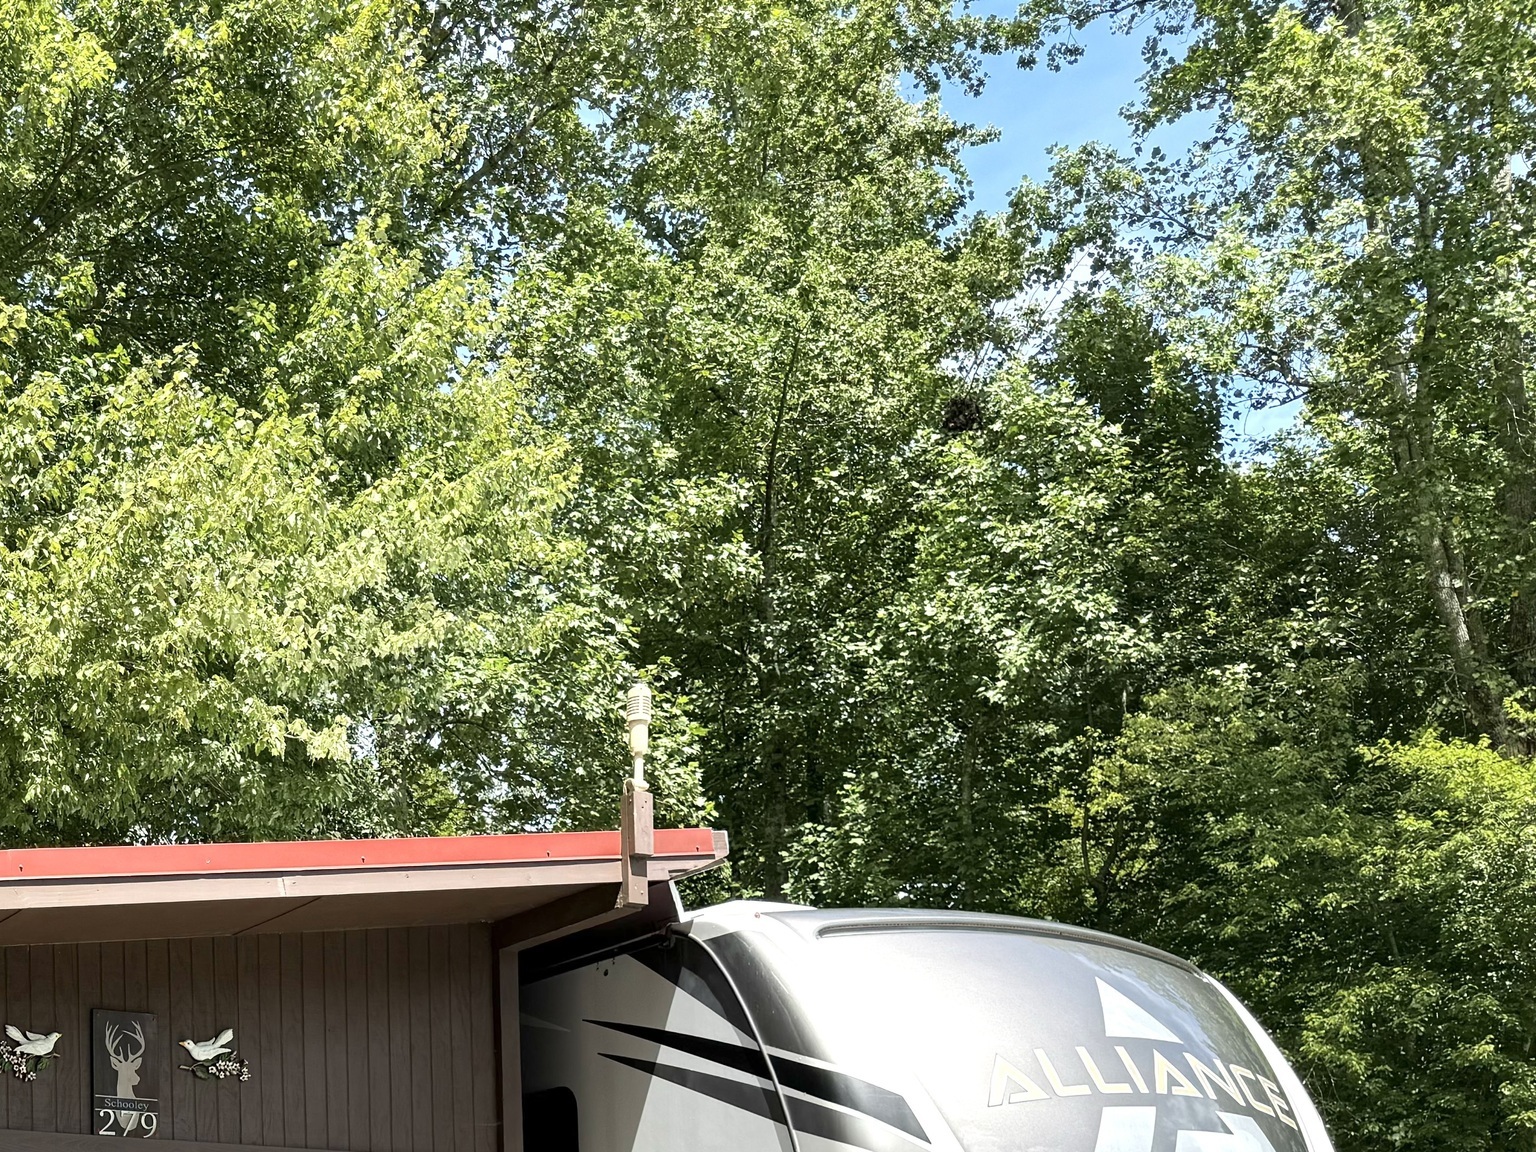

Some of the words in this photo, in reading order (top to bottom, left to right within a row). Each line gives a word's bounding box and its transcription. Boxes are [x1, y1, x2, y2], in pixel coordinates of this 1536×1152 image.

[987, 1045, 1299, 1131] ALLIANCE
[104, 1098, 150, 1112] Schooley
[98, 1108, 158, 1139] 279
